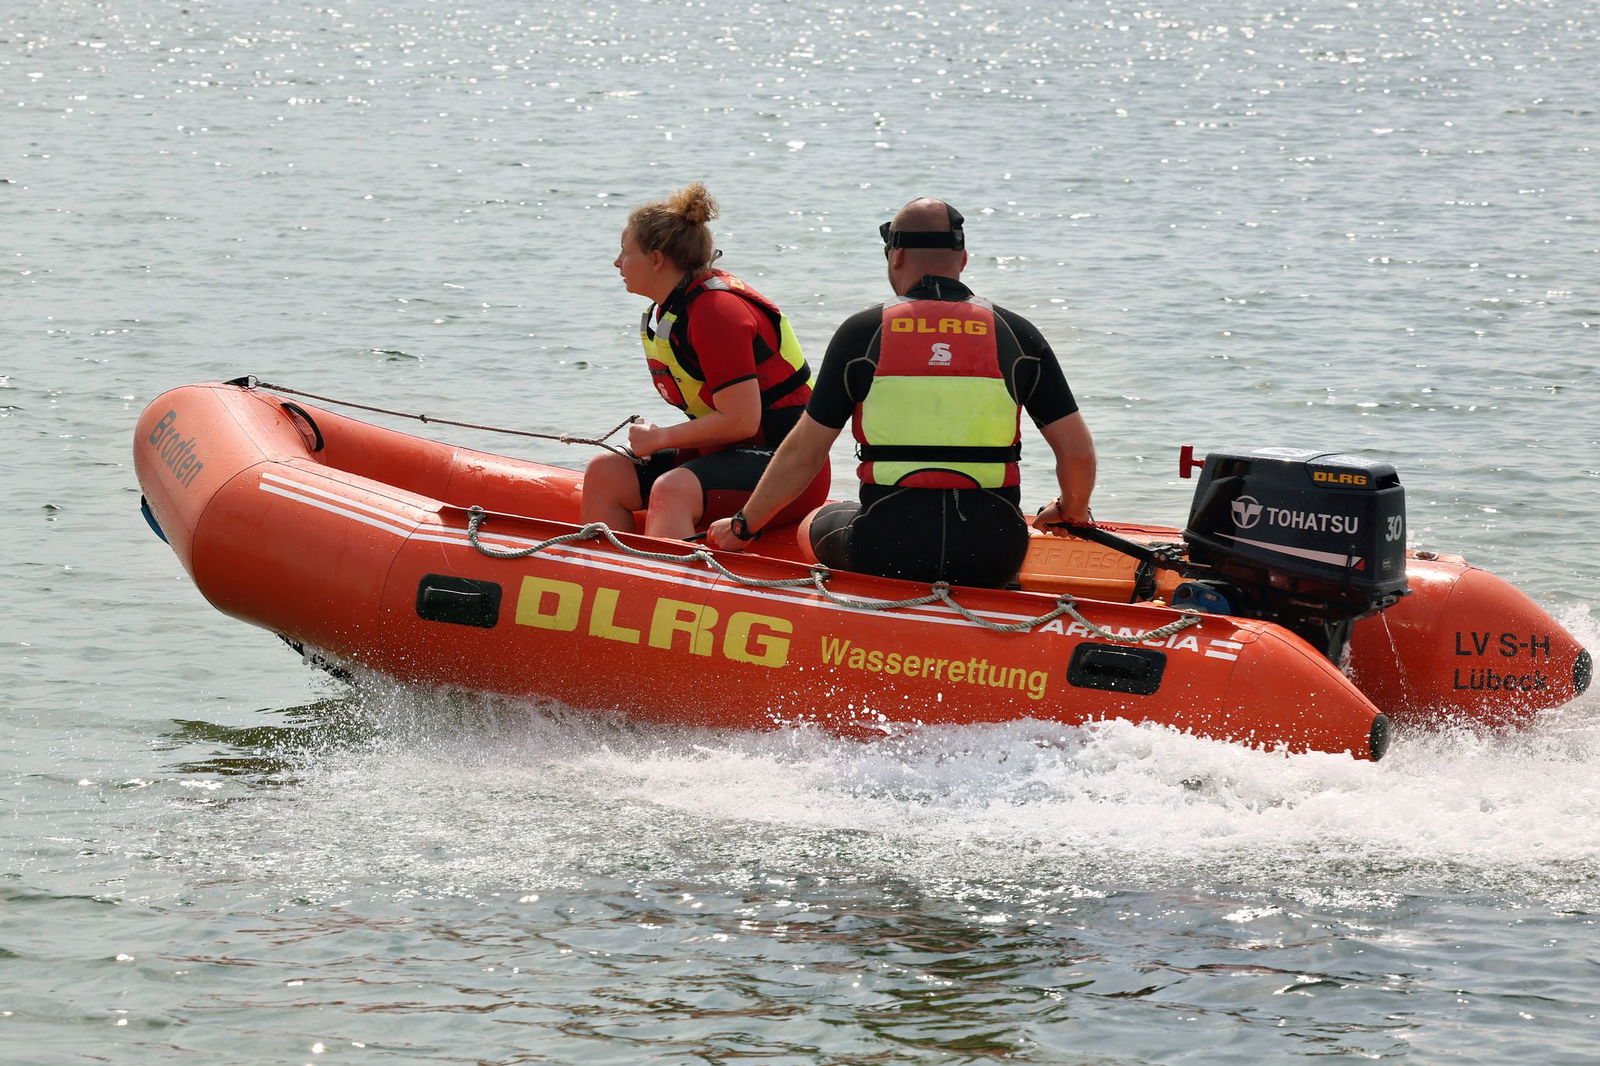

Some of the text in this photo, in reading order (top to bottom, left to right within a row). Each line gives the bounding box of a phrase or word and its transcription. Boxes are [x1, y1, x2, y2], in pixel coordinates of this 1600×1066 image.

[890, 317, 988, 336] DLRG
[149, 409, 204, 489] Brodten
[1313, 471, 1368, 486] DLRG
[1266, 507, 1359, 535] TOHATSU
[1385, 514, 1403, 542] 30
[1029, 546, 1139, 570] RF RESC
[515, 575, 794, 669] DLRG
[1455, 631, 1550, 658] LV S-H
[820, 635, 1049, 700] Wasserrettung
[1453, 667, 1550, 692] Lübeck
